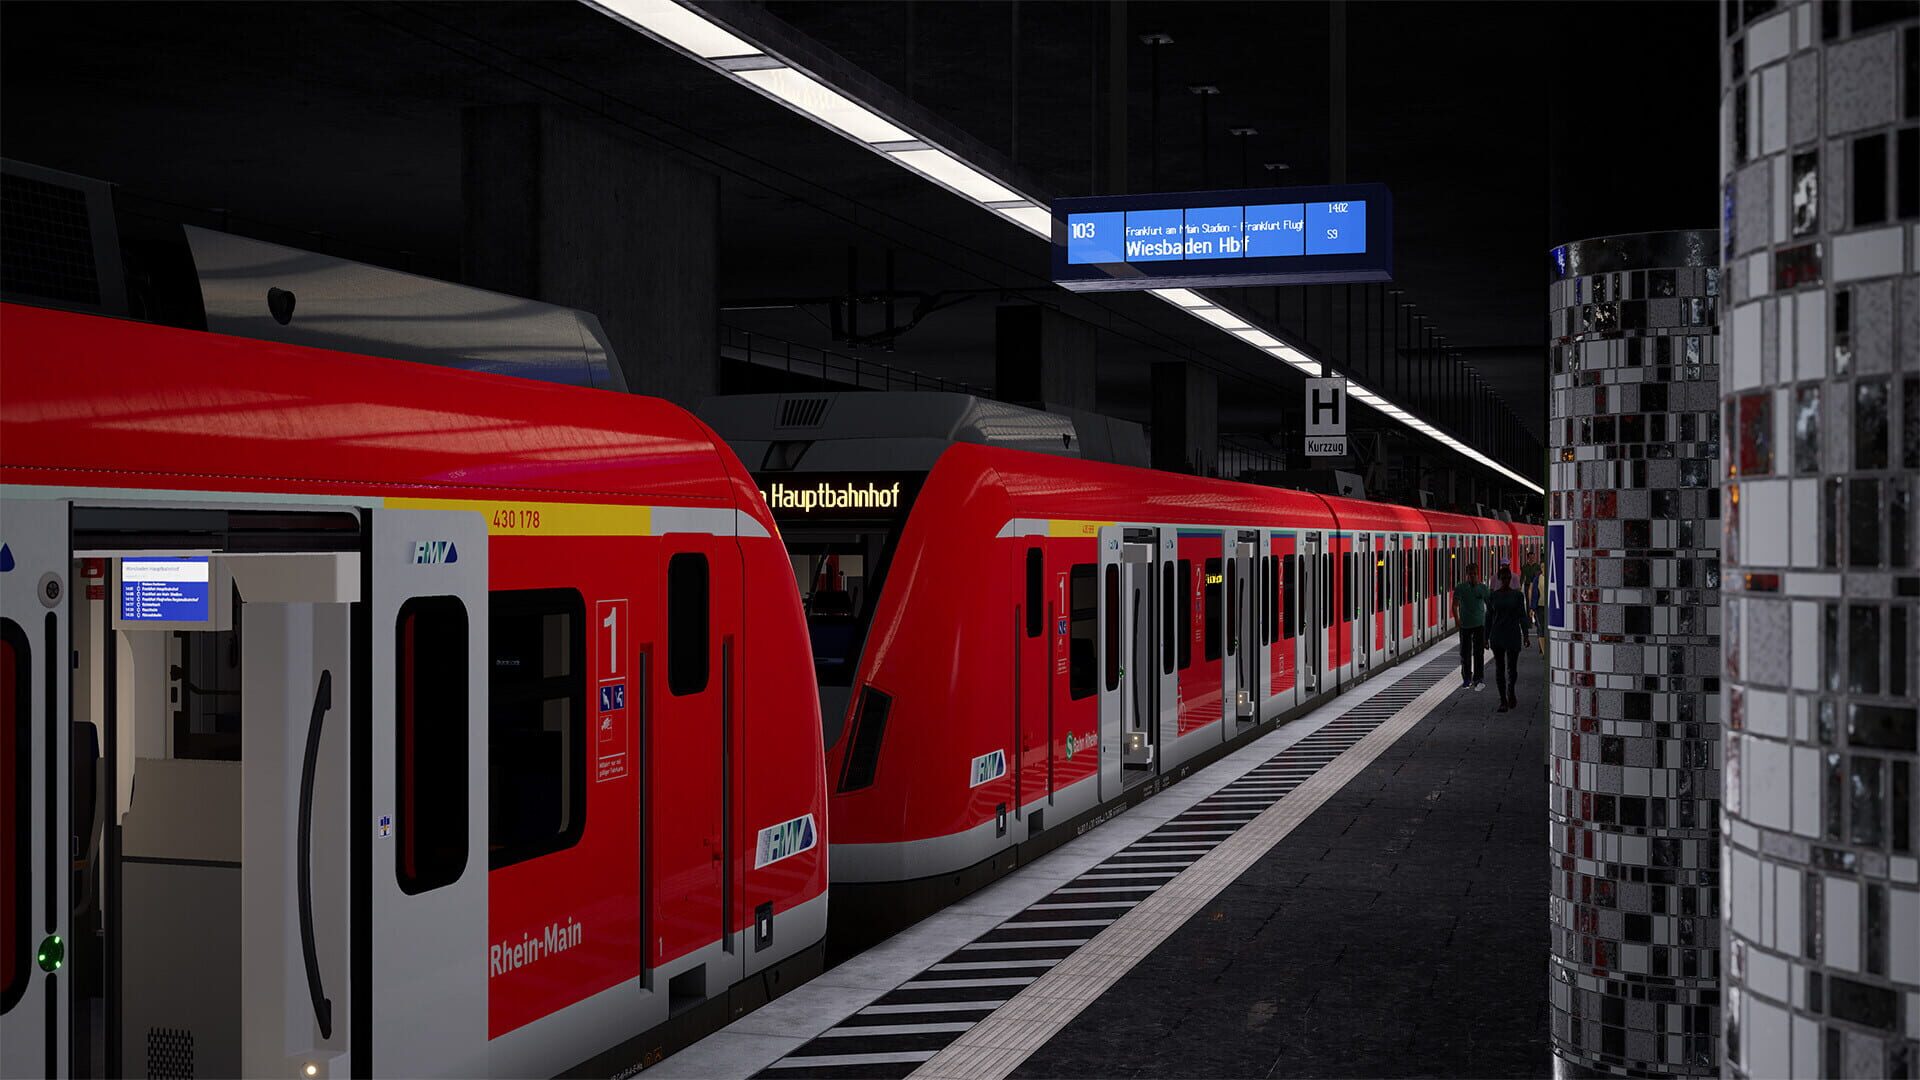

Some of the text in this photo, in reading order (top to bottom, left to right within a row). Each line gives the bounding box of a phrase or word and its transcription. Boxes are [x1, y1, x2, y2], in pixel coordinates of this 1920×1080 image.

[1071, 223, 1095, 239] 103
[1126, 226, 1162, 237] Frankfurt
[1165, 227, 1177, 235] am
[1179, 224, 1199, 234] Main
[1202, 223, 1230, 233] Stadion
[1240, 220, 1281, 232] Frankfurt
[1327, 229, 1338, 239] S9
[1126, 237, 1212, 257] Wiesbaden
[1312, 389, 1339, 425] H
[1308, 440, 1344, 455] Kurzzug
[771, 482, 900, 513] Hauptbahnhof
[493, 510, 540, 528] 430 178
[1547, 541, 1560, 609] A
[1059, 576, 1065, 614] 1
[603, 606, 617, 673] 1
[767, 816, 808, 863] RMV
[490, 916, 582, 978] Rhein-Main
